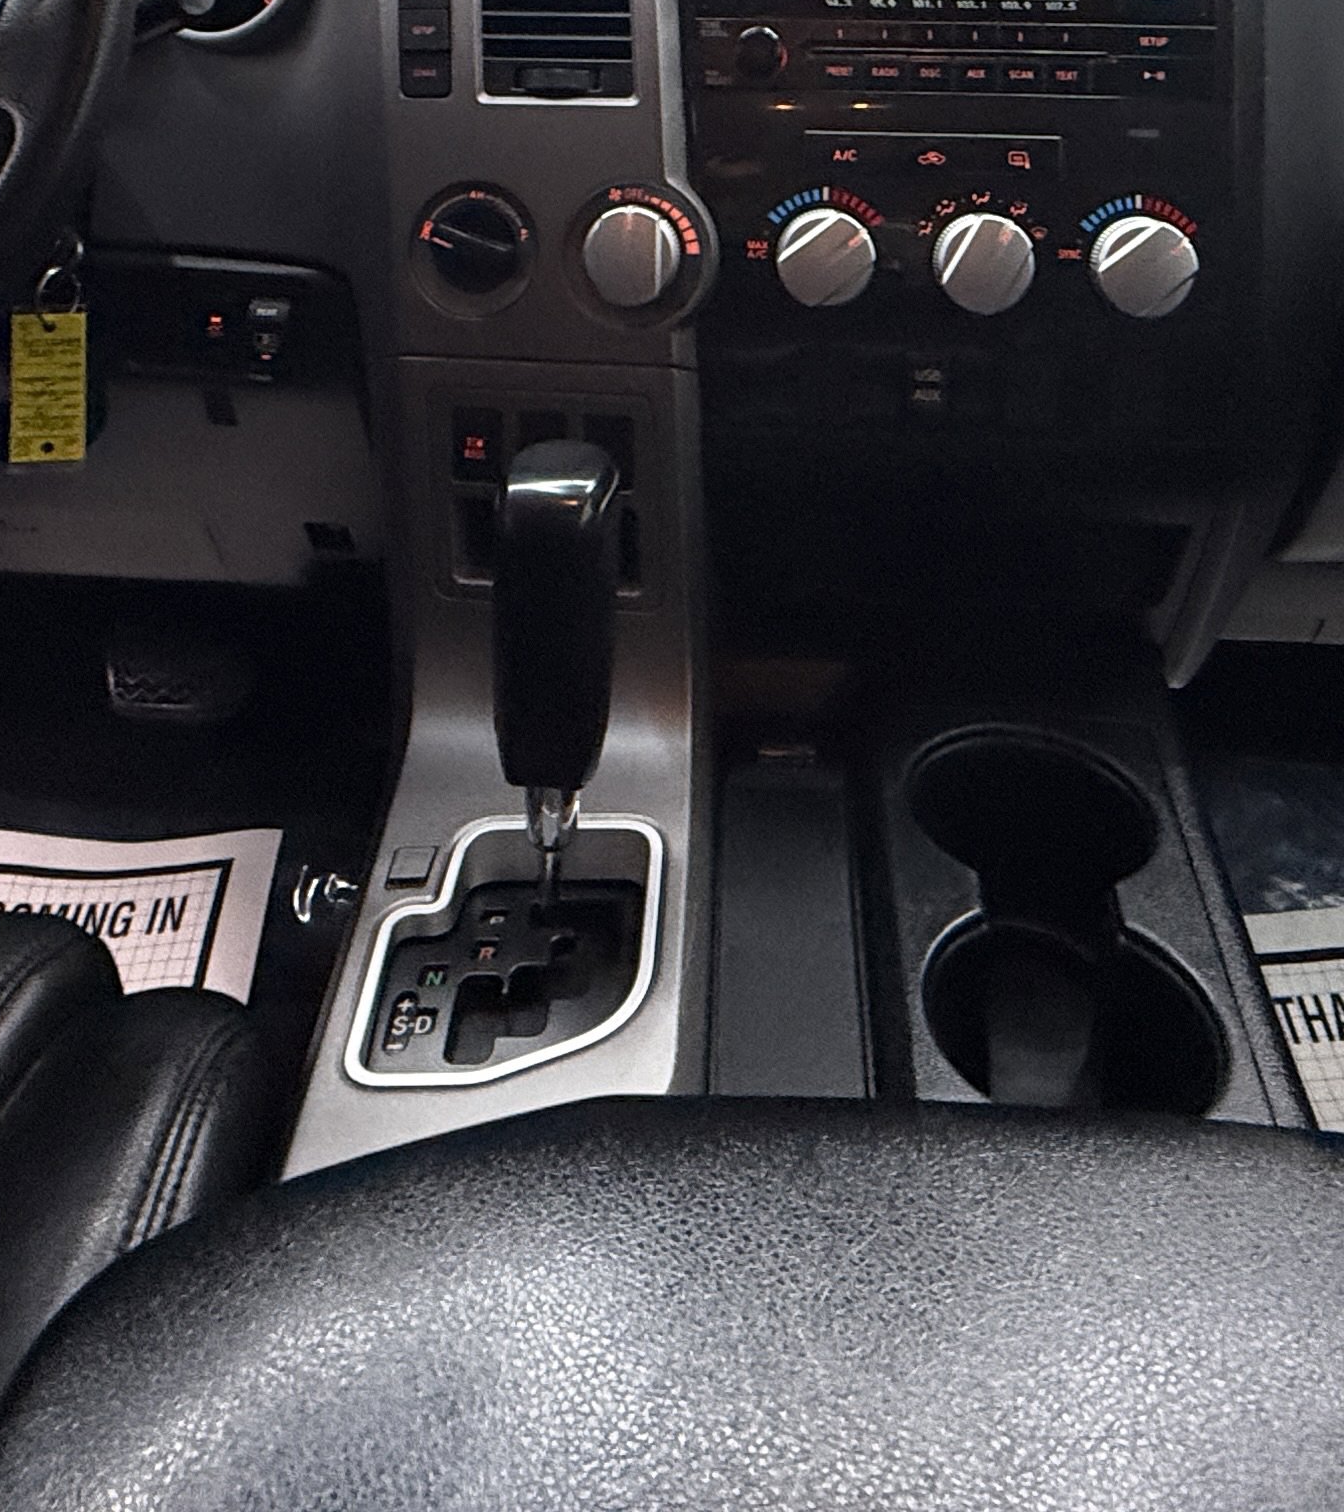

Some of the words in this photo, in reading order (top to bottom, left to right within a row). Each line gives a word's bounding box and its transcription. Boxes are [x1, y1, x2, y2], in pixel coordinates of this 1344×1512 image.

[1138, 36, 1169, 48] SETUP
[871, 66, 899, 78] RADIO
[920, 67, 942, 79] DISC
[966, 68, 987, 79] AUX
[1008, 69, 1035, 80] SCAN
[1055, 70, 1079, 81] TEXT
[832, 149, 858, 162] A/C
[746, 239, 769, 249] MAX
[746, 249, 768, 260] A/C
[1057, 248, 1083, 260] SYNC
[146, 895, 188, 935] IN
[478, 946, 497, 961] R
[424, 970, 444, 986] N
